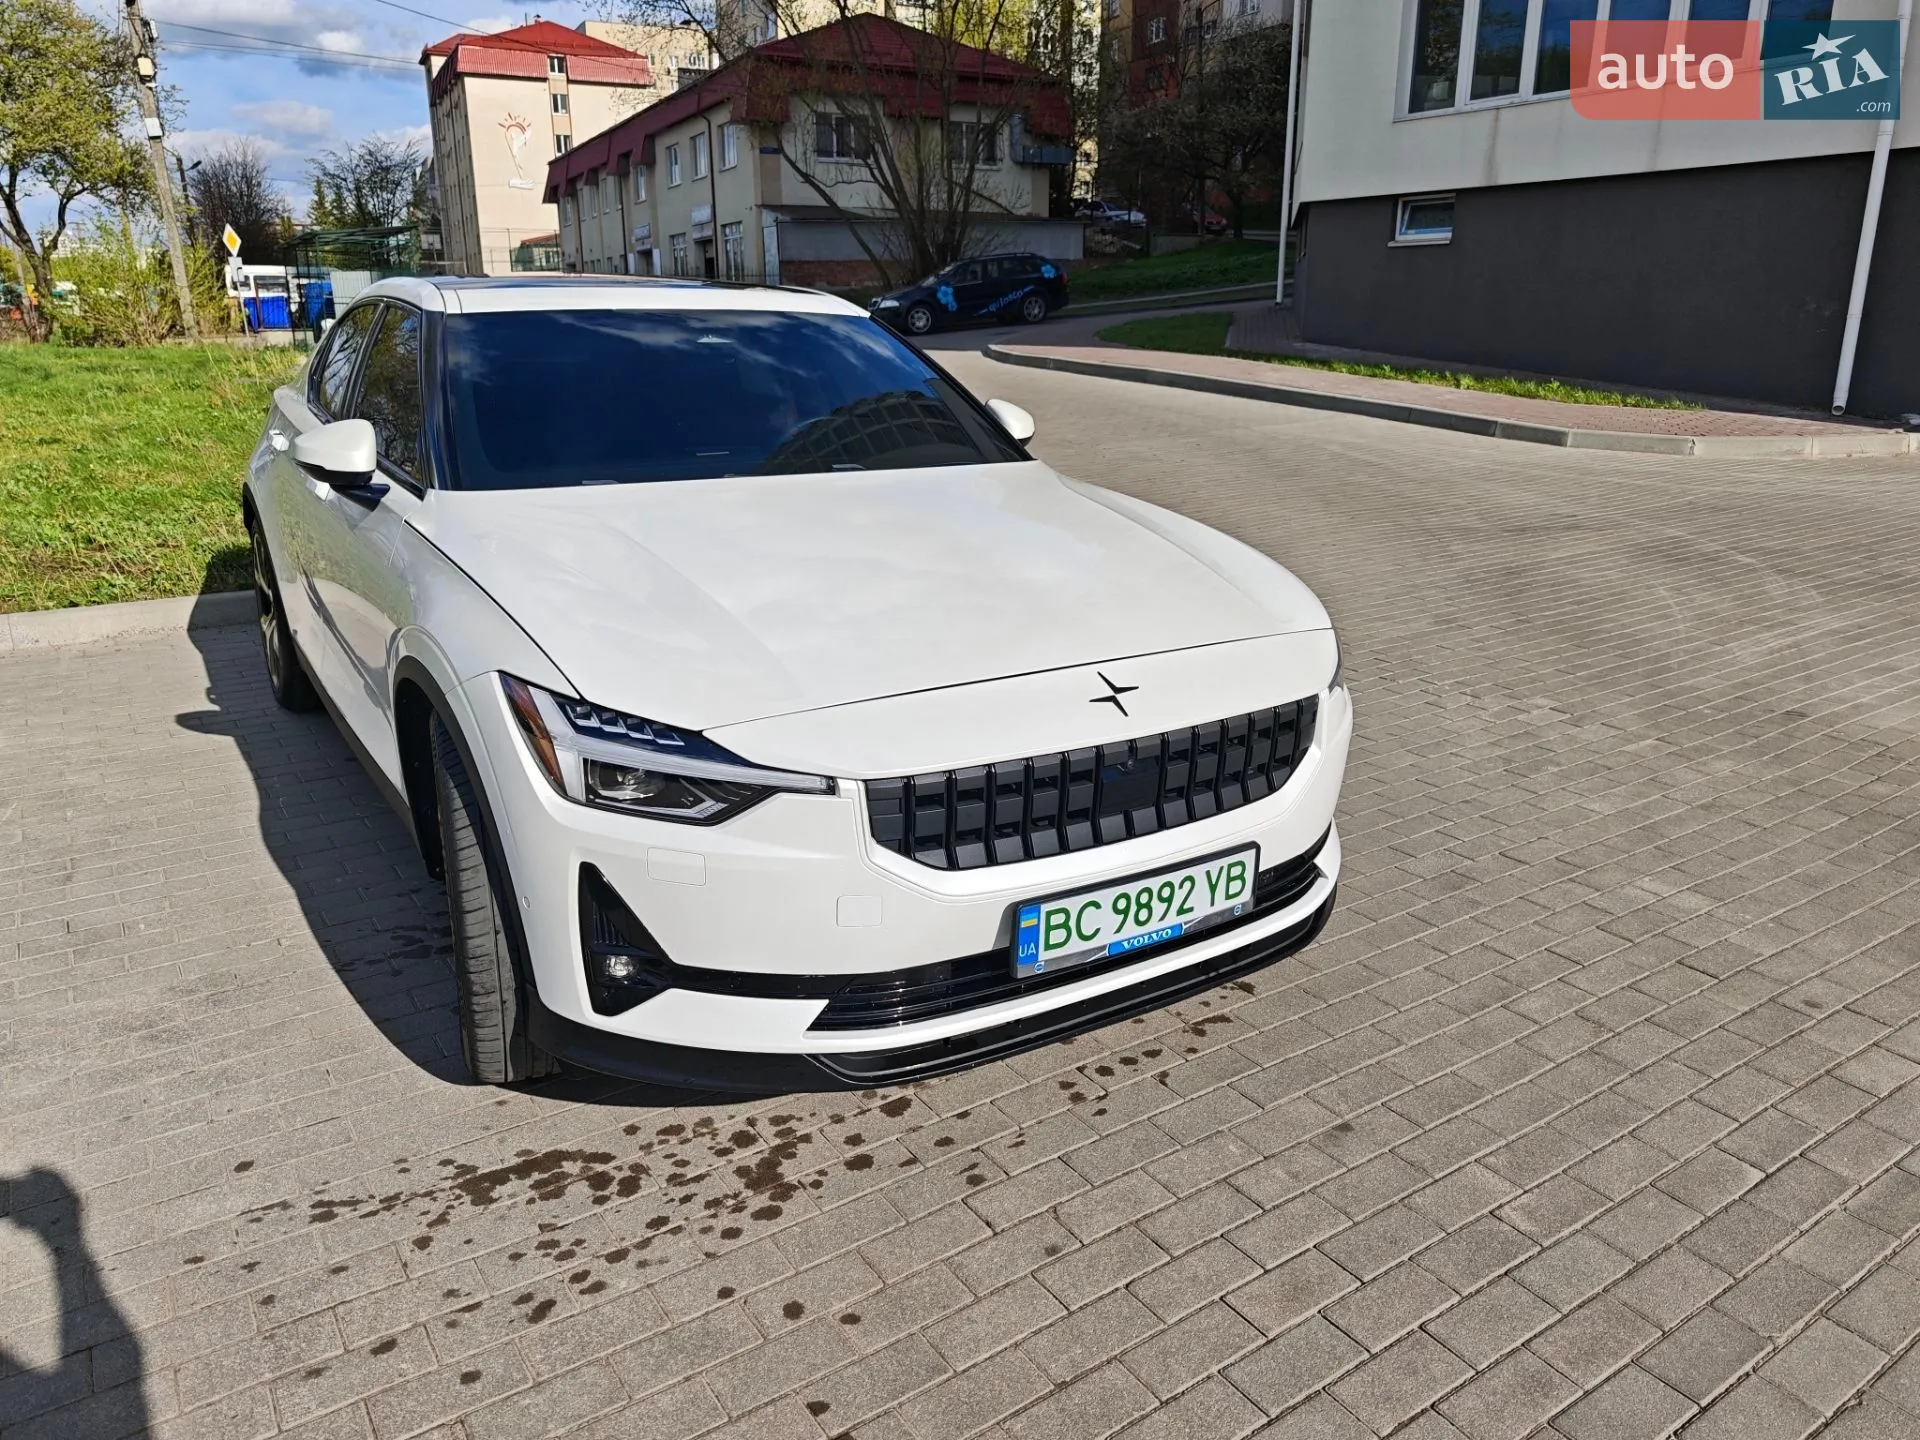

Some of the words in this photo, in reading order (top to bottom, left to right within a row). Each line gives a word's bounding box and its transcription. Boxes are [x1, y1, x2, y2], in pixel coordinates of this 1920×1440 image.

[1043, 900, 1102, 952] BC
[1111, 875, 1196, 934] 9892
[1205, 860, 1247, 907] YB
[1121, 928, 1172, 950] VOLVO
[1019, 944, 1036, 958] UA
